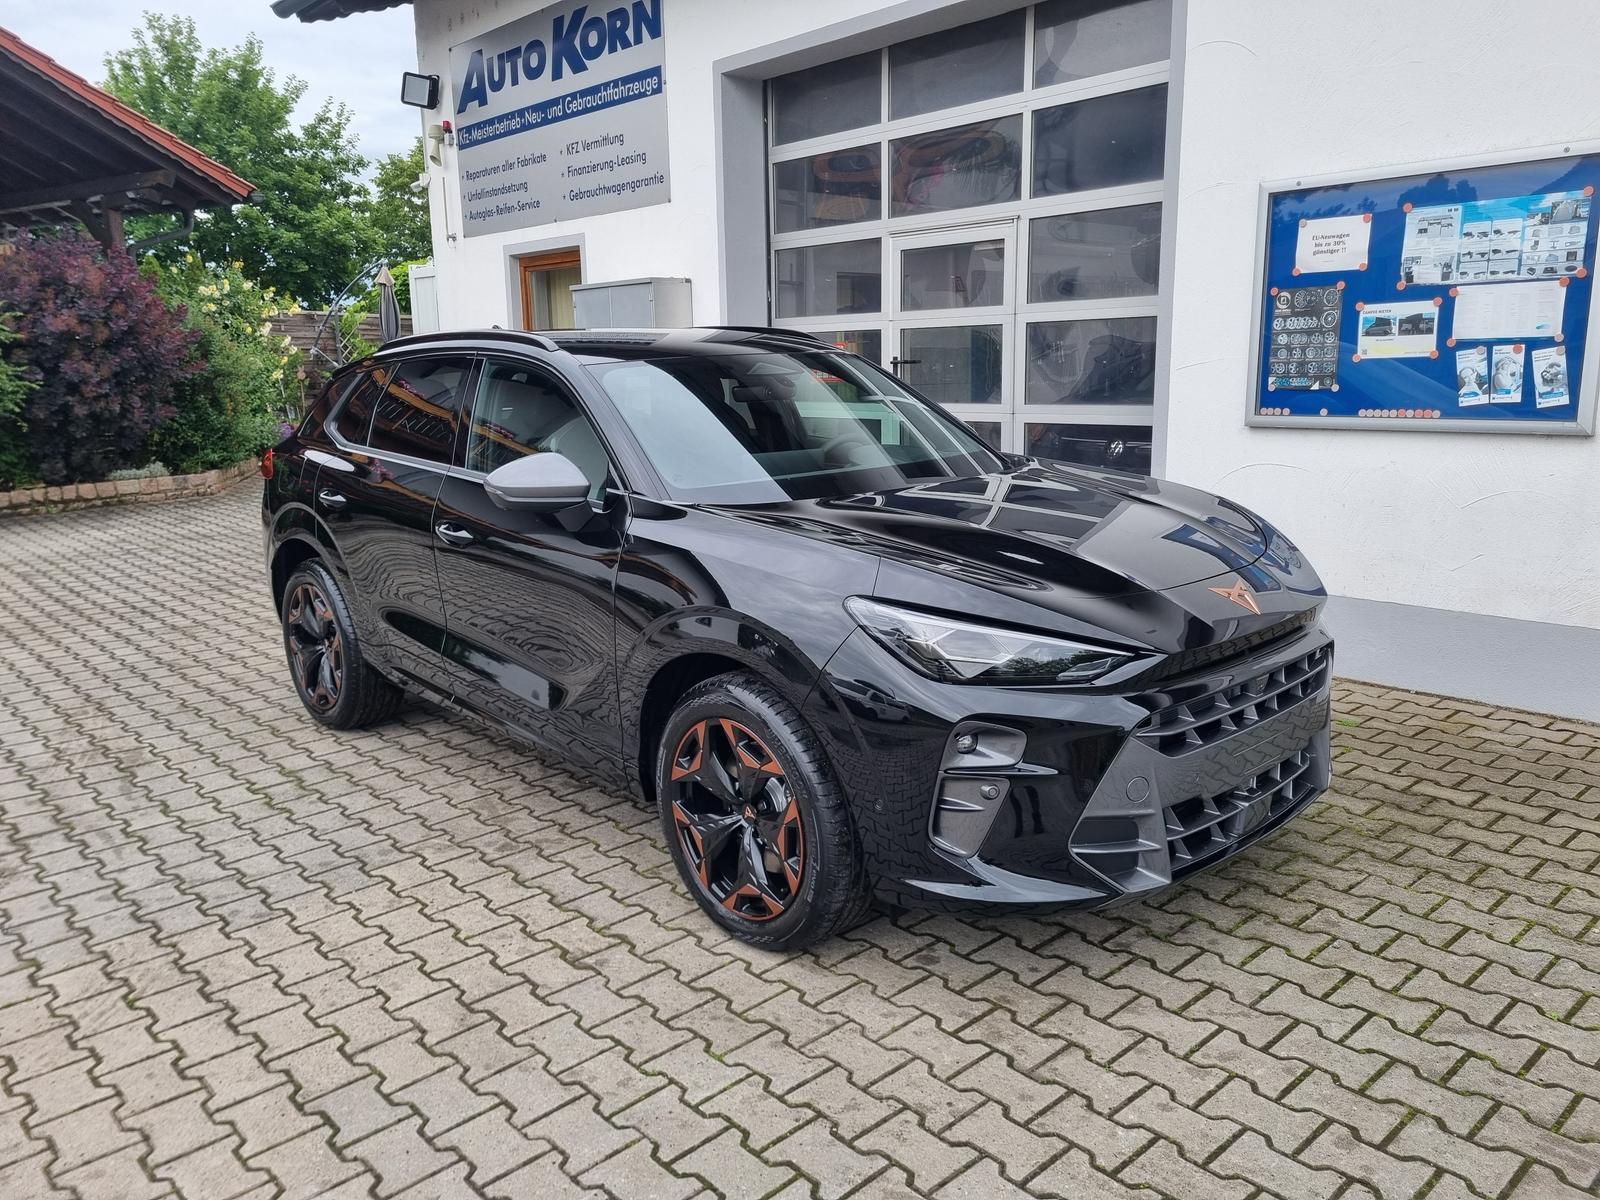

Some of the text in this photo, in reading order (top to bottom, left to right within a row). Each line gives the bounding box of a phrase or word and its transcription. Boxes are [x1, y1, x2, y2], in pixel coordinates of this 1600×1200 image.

[457, 0, 662, 115] AUTO KORN
[458, 76, 658, 147] Kfz-Meisterbetrieb Neu- und Gebrauchtfahrzeuge
[566, 132, 624, 156] KFZ Vermittlung
[465, 152, 547, 183] Reparaturen aller Fabrikate
[567, 150, 647, 178] Finanzierung-Leasing
[467, 181, 528, 202] Unfallinstandsetzung
[569, 171, 665, 201] Gebrauchtwagengarantie
[469, 198, 541, 221] Autoglas-Reifen-Service
